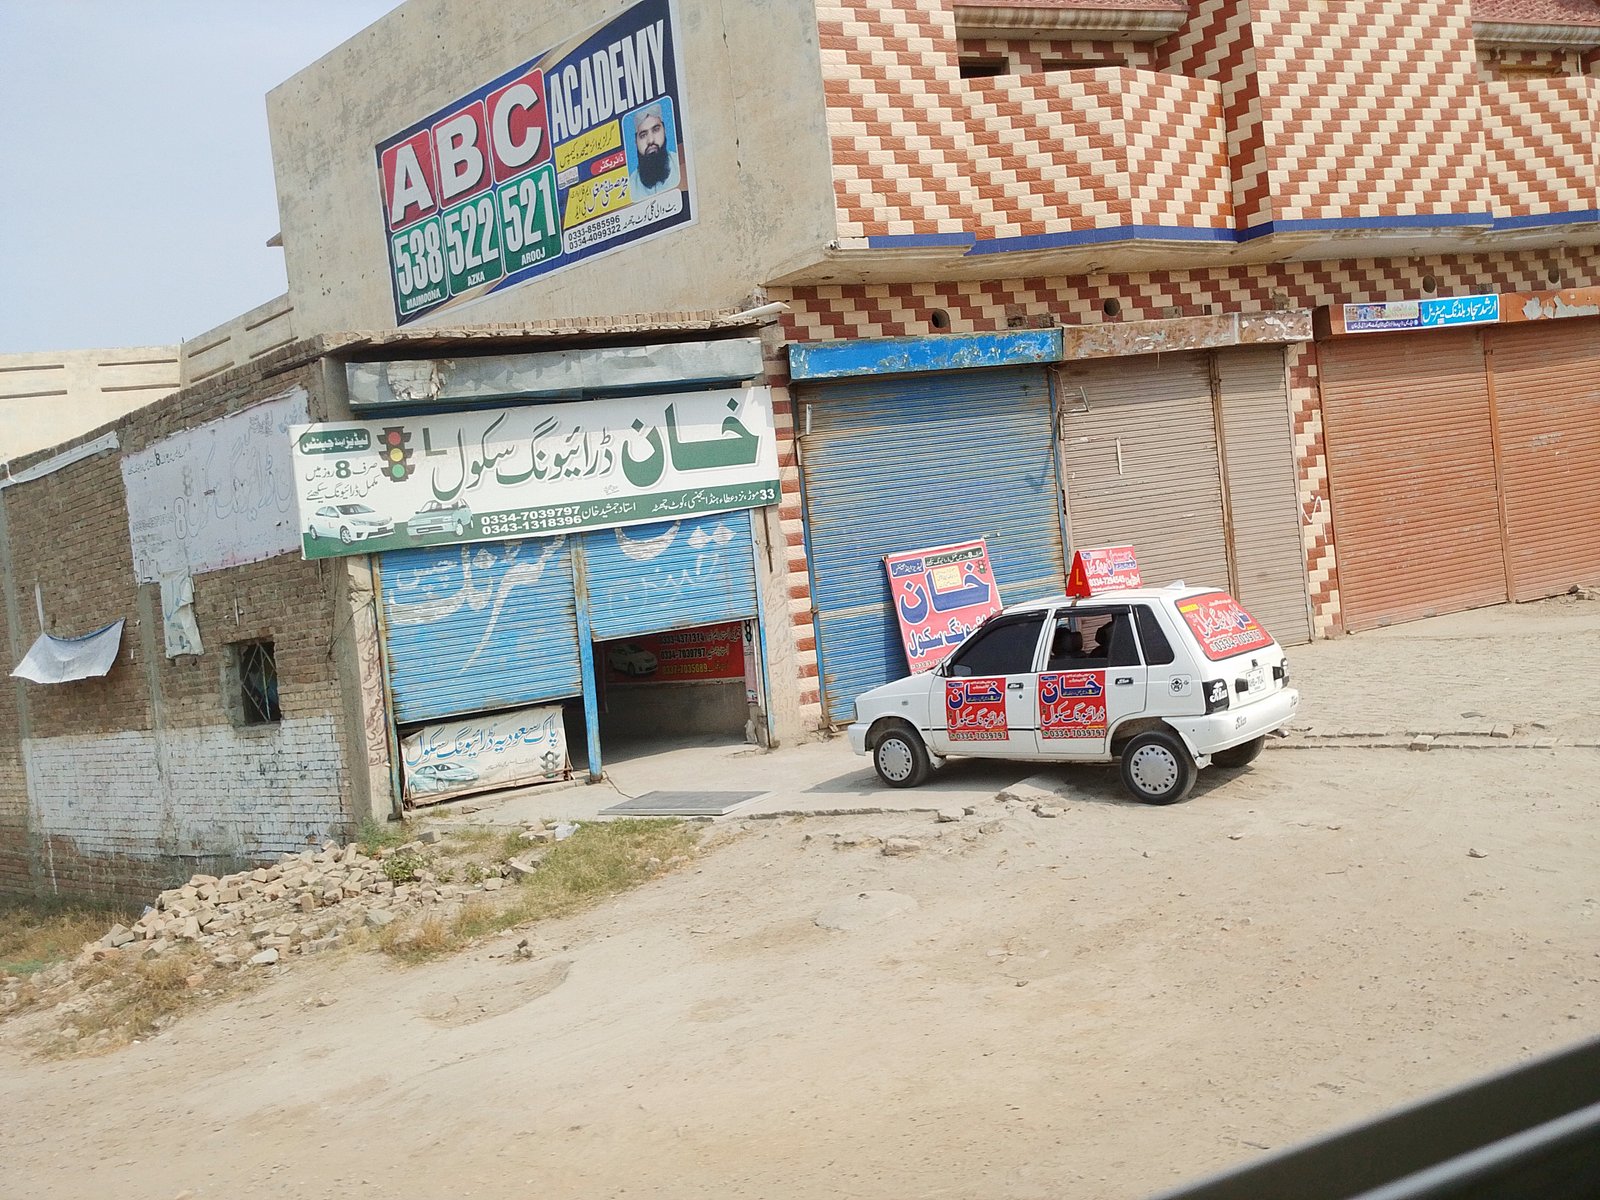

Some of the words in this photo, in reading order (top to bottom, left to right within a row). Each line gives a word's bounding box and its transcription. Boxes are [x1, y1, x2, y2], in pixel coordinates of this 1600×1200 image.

[551, 19, 666, 144] ACADEMY
[599, 153, 625, 173] ڈائریکٹر
[501, 170, 557, 253] 521
[444, 197, 500, 276] 522
[568, 215, 621, 242] 0333-8585596
[569, 223, 622, 250] 0334-4099322
[394, 220, 444, 296] 538
[521, 247, 546, 266] AROOJ
[467, 271, 486, 287] AZKA
[406, 288, 442, 310] MAIMOONA
[1478, 297, 1497, 316] ارشد
[1466, 301, 1482, 321] سجاد
[302, 437, 334, 453] جینٹس
[343, 432, 369, 451] لیڈیز
[422, 427, 447, 457] L
[496, 415, 614, 485] ڈرائیونگ
[621, 397, 760, 488] خان
[432, 411, 515, 502] سکول
[305, 465, 322, 482] میں
[322, 468, 336, 479] روز
[335, 460, 352, 479] 8
[352, 462, 378, 476] صرف
[324, 482, 360, 500] ڈرائیونگ
[358, 474, 380, 498] مکمل
[759, 488, 775, 501] 33
[599, 502, 620, 519] جمشید
[618, 502, 637, 515] استاد
[669, 494, 687, 509] کوٹ
[481, 505, 582, 526] 0334-7039797
[581, 506, 600, 520] خان
[482, 515, 583, 536] 0343-1318396
[1076, 568, 1083, 586] L
[899, 562, 990, 625] خان
[908, 627, 945, 658] سکول
[948, 681, 1004, 710] خان
[1041, 673, 1104, 704] خان
[406, 725, 449, 767] سکول
[436, 722, 498, 759] ڈرائیونگ
